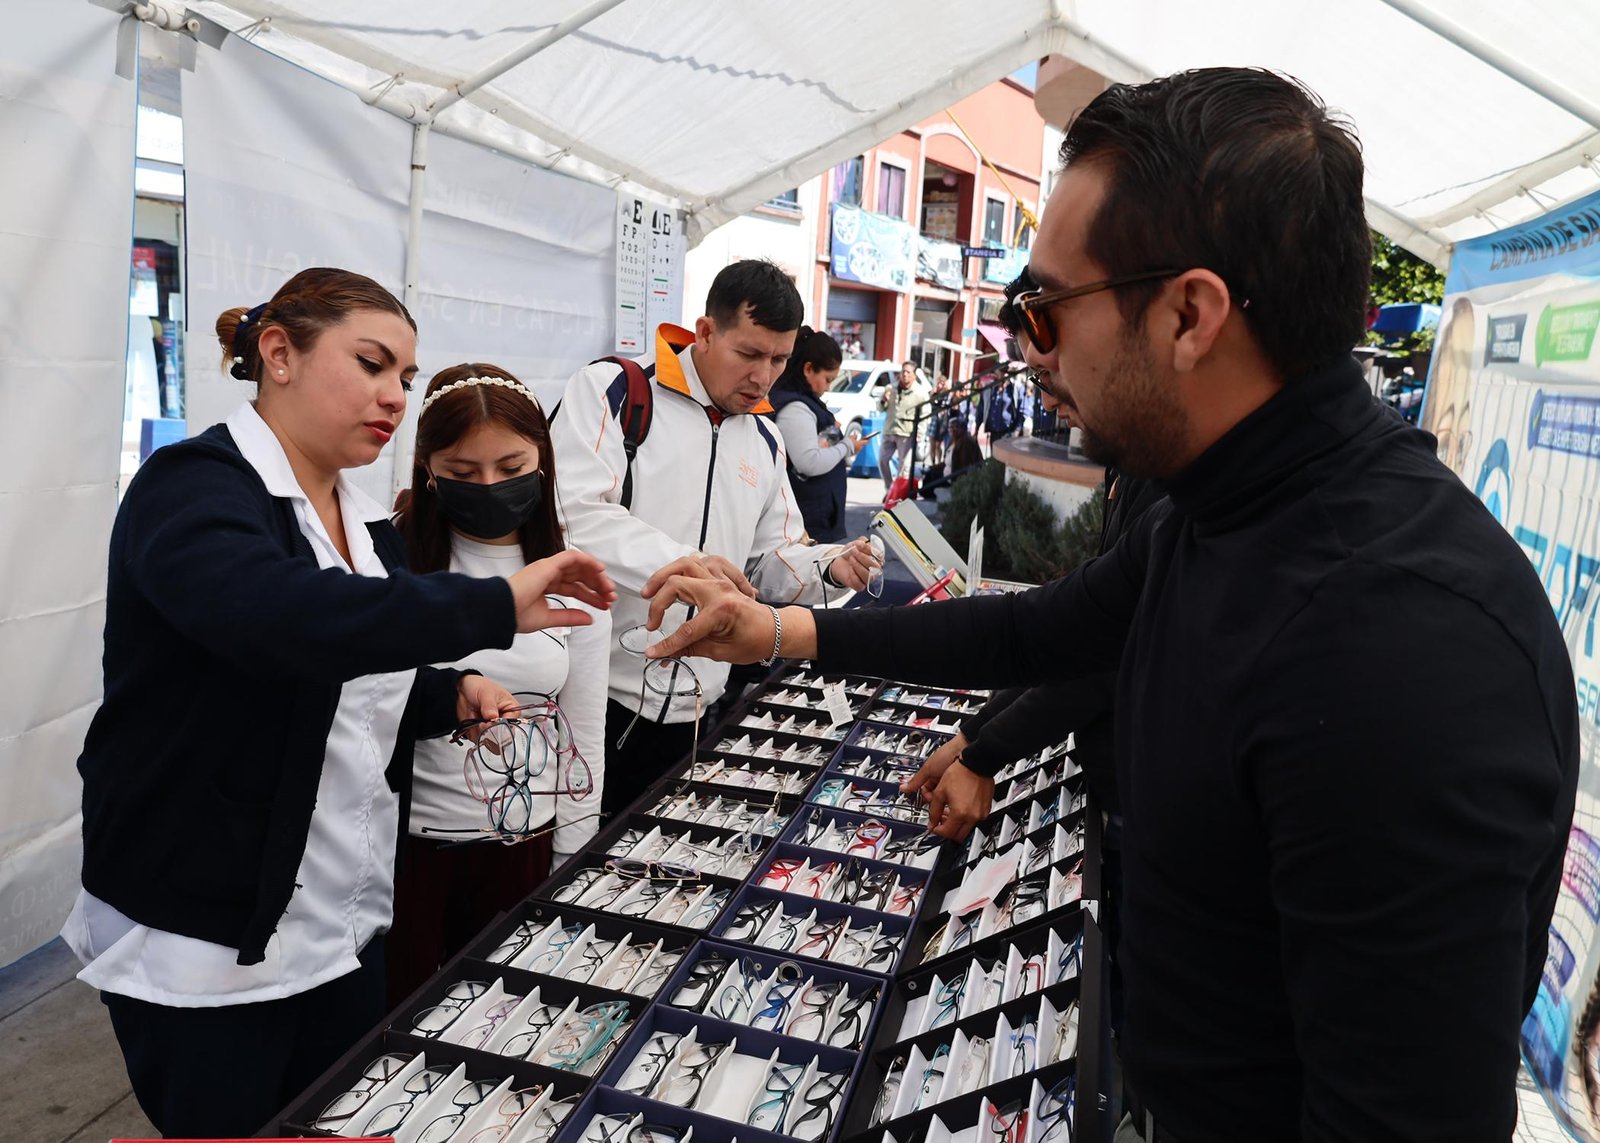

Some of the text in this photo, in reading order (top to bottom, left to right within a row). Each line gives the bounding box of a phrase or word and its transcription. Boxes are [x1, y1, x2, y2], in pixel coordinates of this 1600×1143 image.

[633, 199, 643, 225] E
[663, 213, 671, 236] E
[1543, 220, 1579, 254] DE
